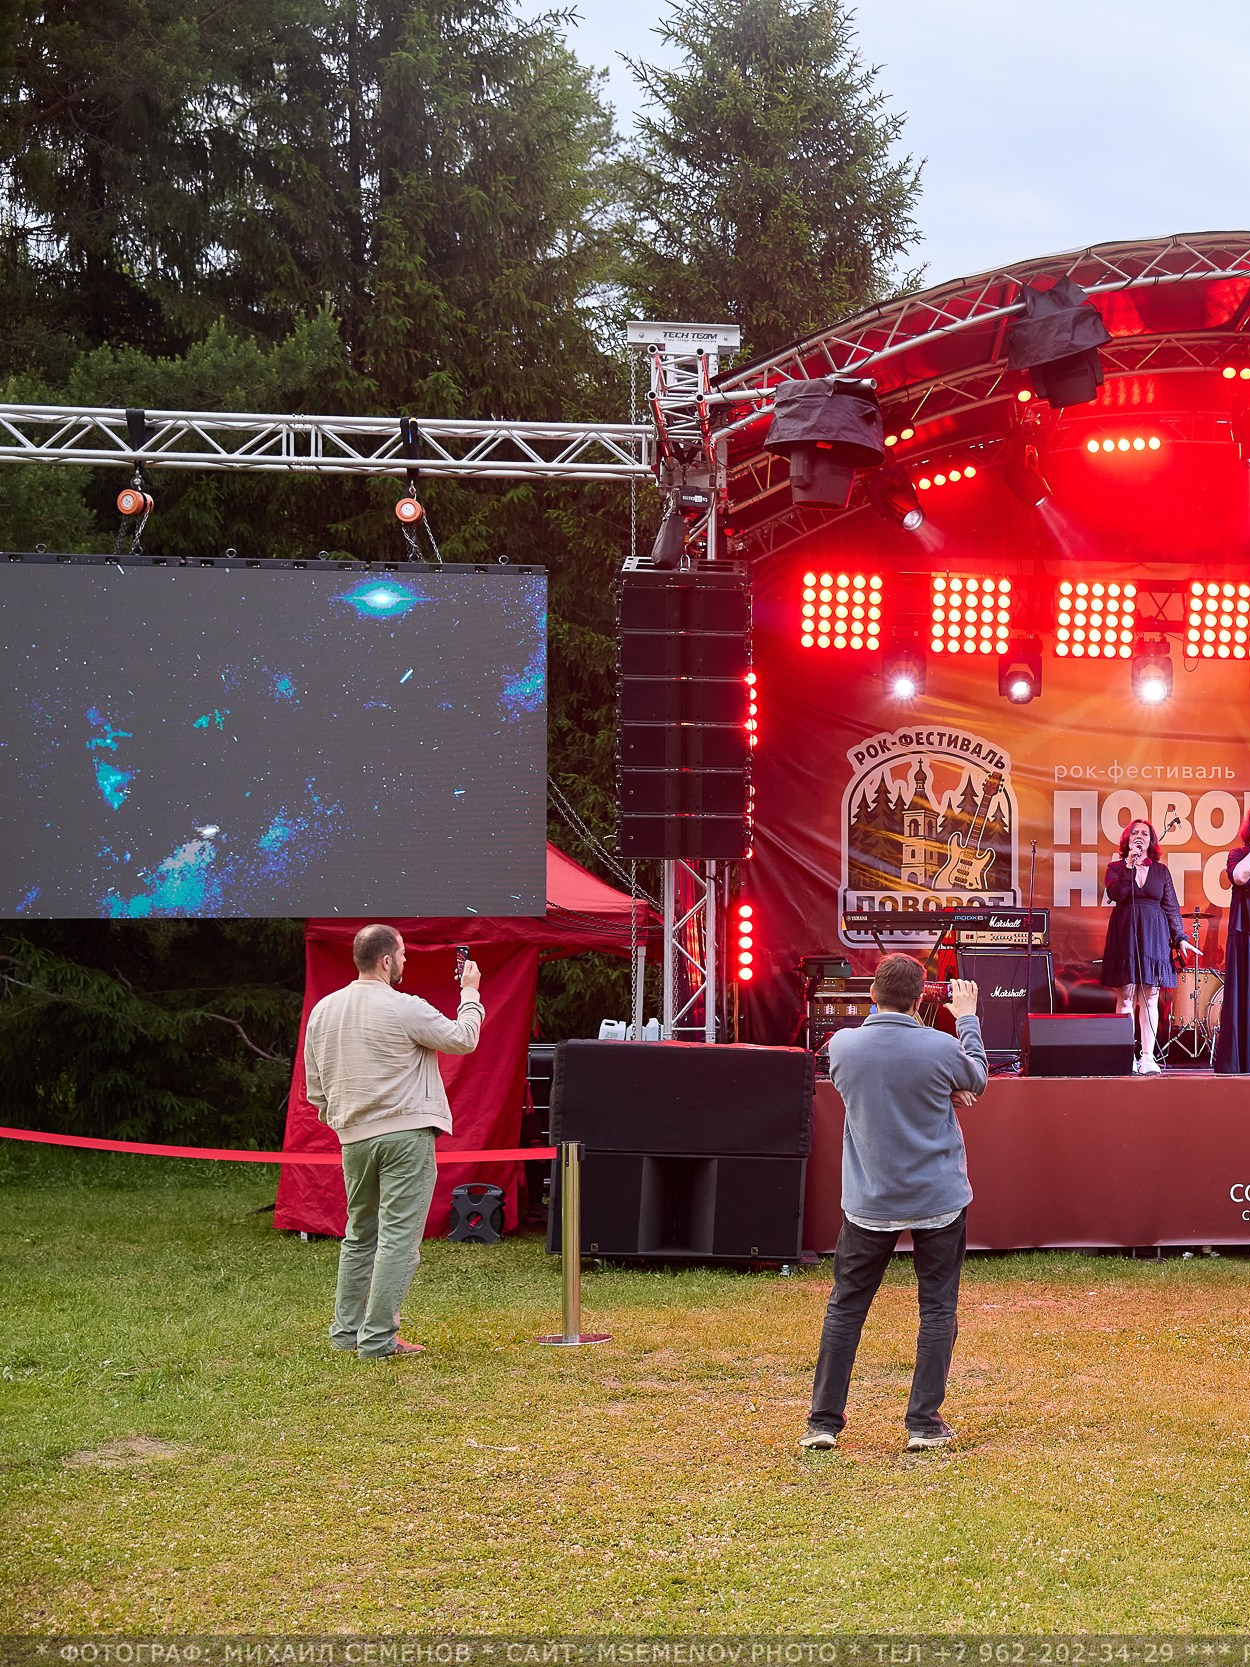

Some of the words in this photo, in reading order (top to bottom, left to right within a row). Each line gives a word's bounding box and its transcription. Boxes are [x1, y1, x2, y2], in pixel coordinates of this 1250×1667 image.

[663, 331, 689, 339] TECH
[853, 731, 1006, 770] РОК-ФЕСТИВАЛЬ
[1054, 760, 1236, 783] рок-фестиваль
[989, 915, 1021, 928] Marshall
